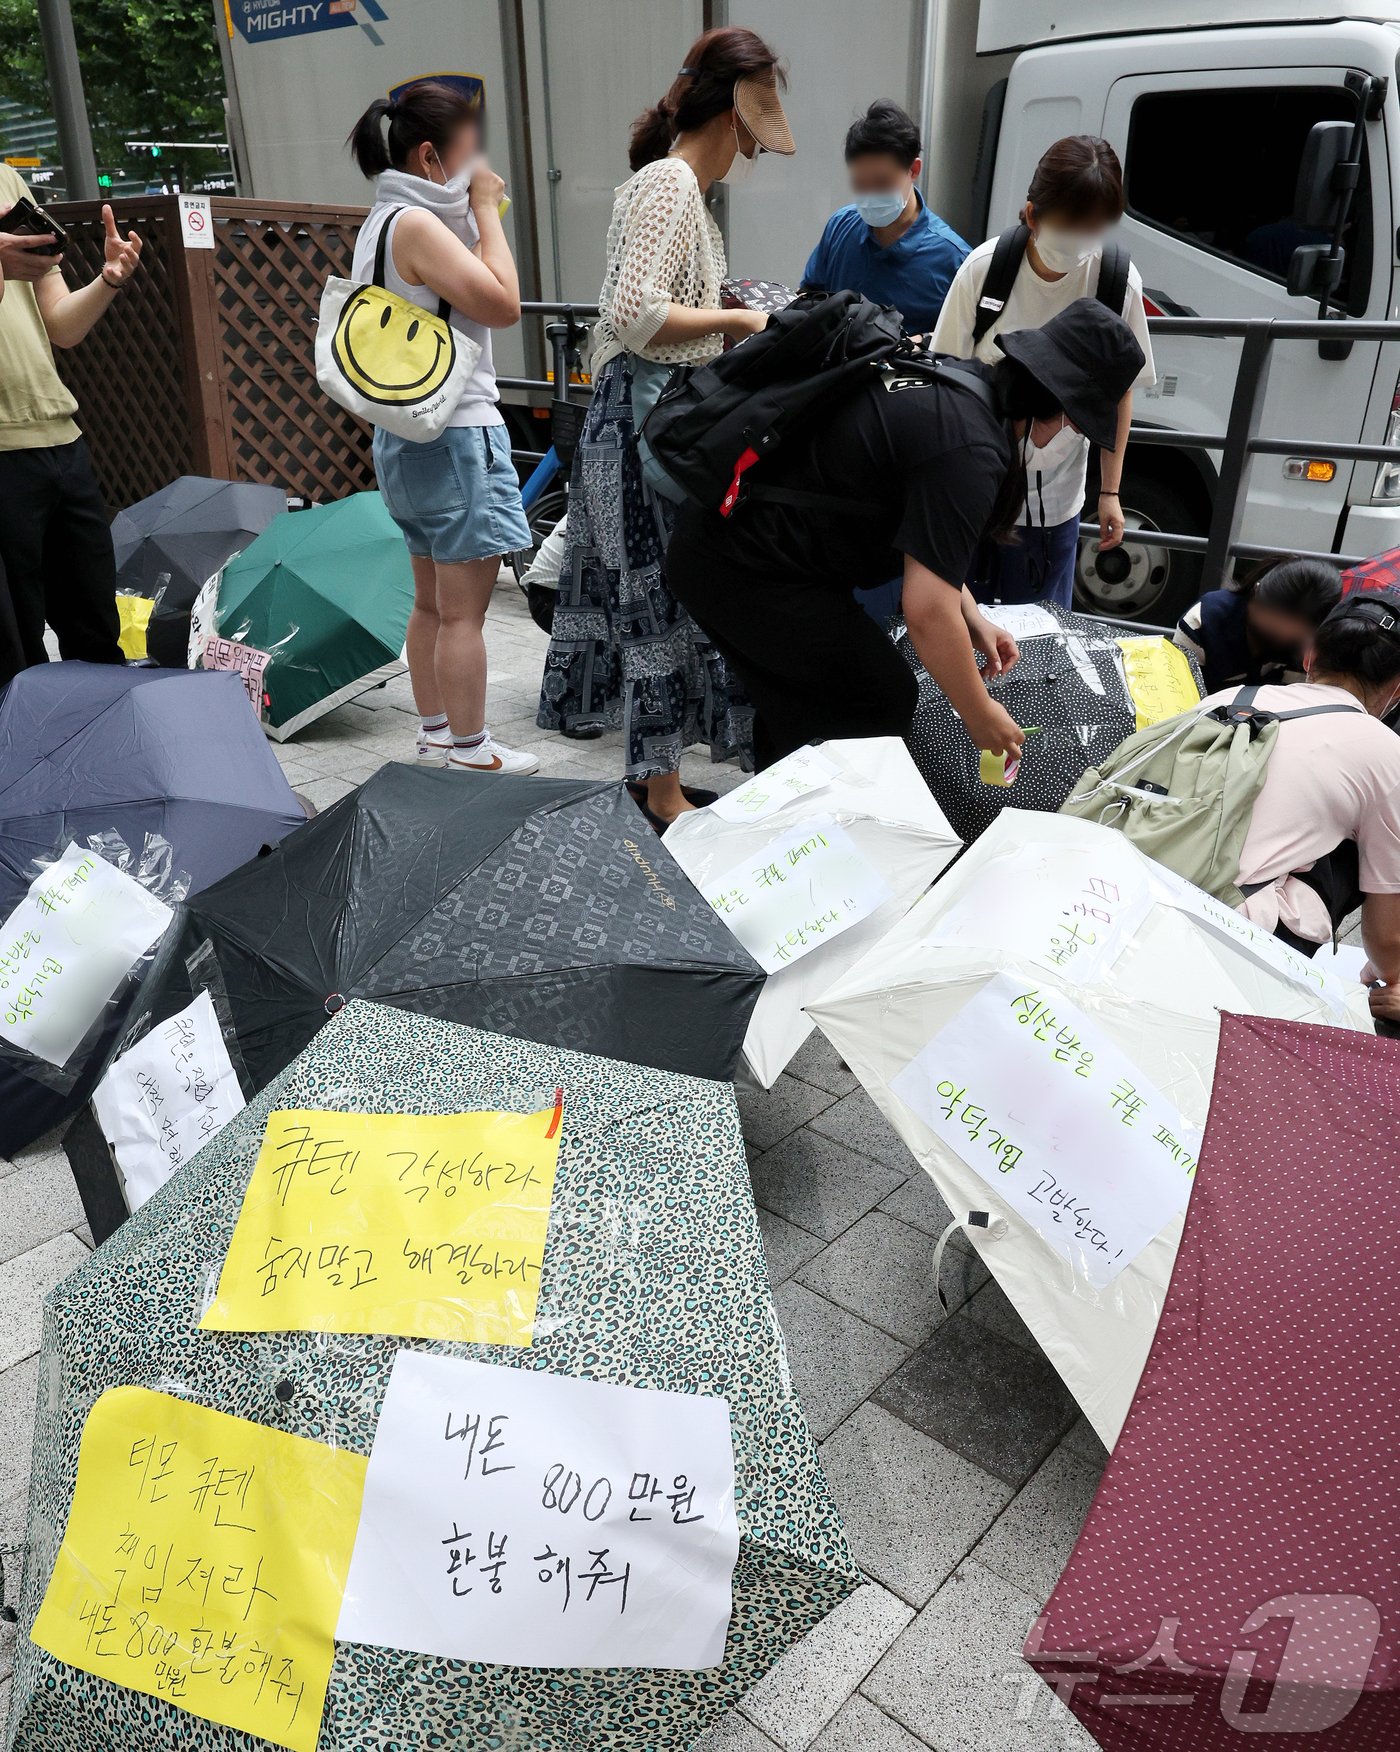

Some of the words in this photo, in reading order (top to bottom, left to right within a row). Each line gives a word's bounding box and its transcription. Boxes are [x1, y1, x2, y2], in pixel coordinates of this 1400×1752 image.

[247, 3, 323, 33] MIGHTY
[207, 640, 231, 666] 티몬
[233, 646, 265, 672] 위메프
[752, 862, 787, 888] 쿠폰
[5, 957, 63, 1025] 악덕기업
[1010, 990, 1094, 1078] 정산받은
[1110, 1078, 1147, 1127] 쿠폰
[936, 1080, 1023, 1174] 악덕기업
[272, 1126, 360, 1206] 큐텐
[386, 1150, 541, 1203] 각성하라
[256, 1237, 377, 1297] 숨지말고
[404, 1238, 542, 1285] 해결하라
[129, 1434, 178, 1503] 티몬
[189, 1456, 256, 1532] 큐텐
[444, 1412, 516, 1480] 내돈
[542, 1463, 612, 1521] 800
[628, 1472, 705, 1524] 만원
[441, 1522, 508, 1597] 환불
[533, 1544, 630, 1615] 해줘
[125, 1611, 177, 1658] 800
[155, 1661, 187, 1697] 만원
